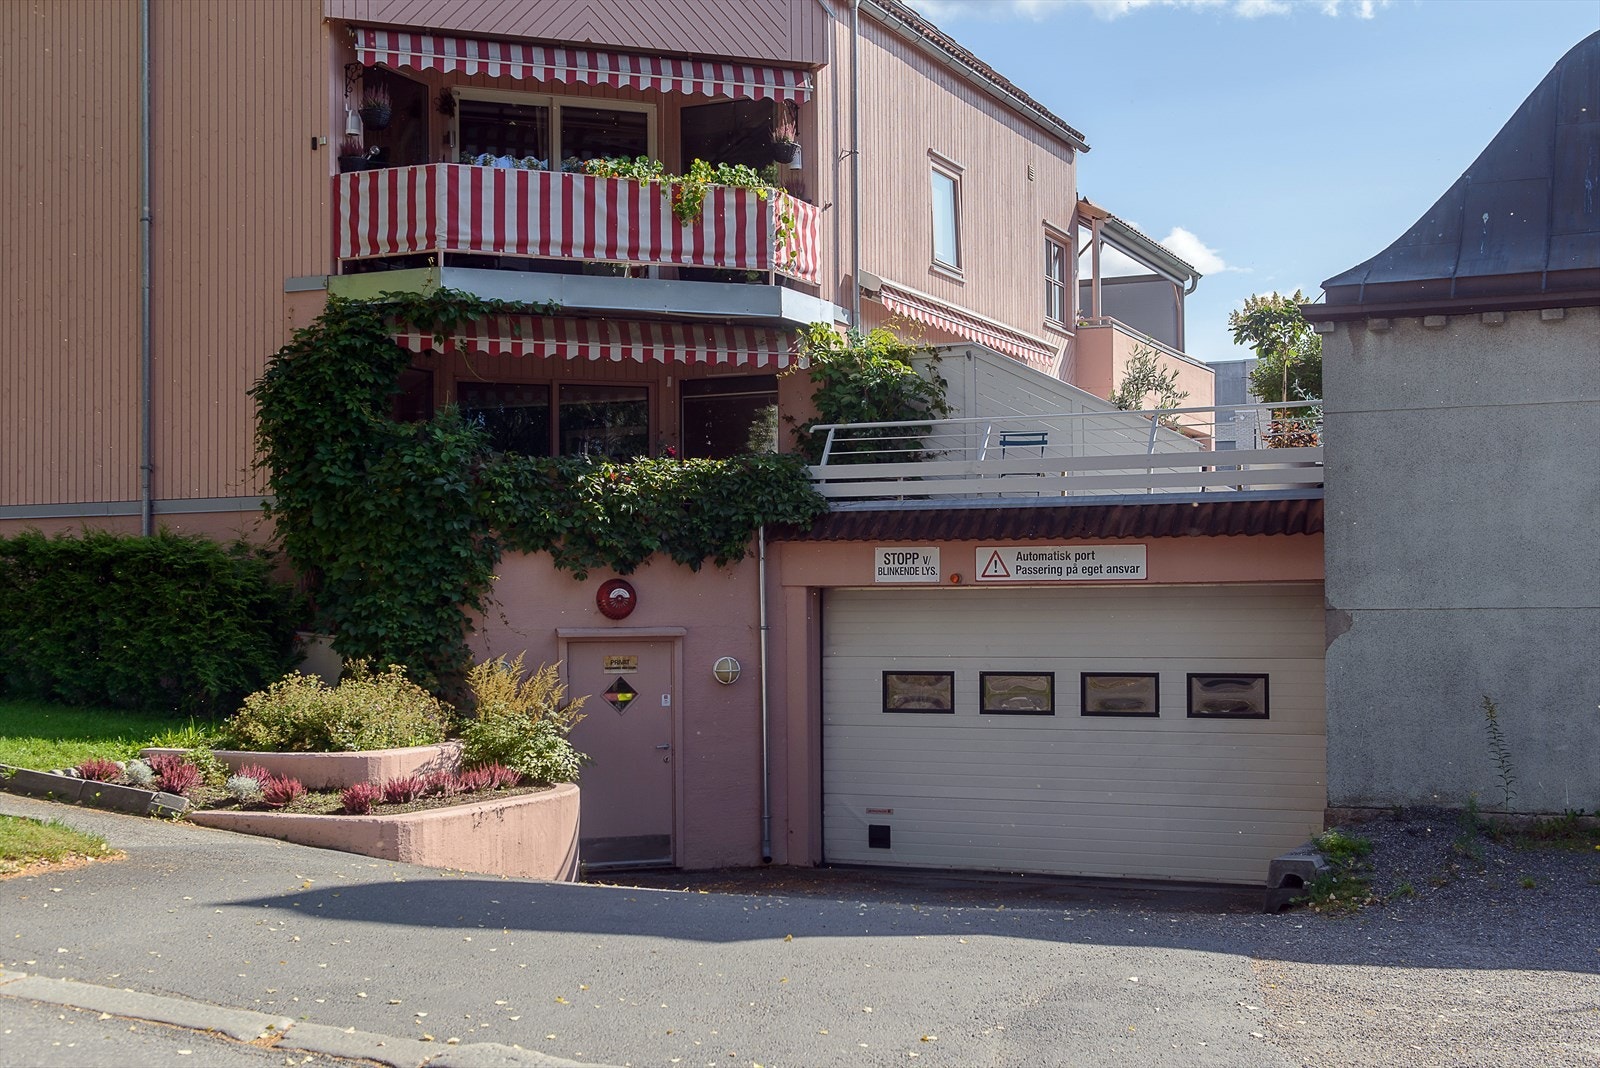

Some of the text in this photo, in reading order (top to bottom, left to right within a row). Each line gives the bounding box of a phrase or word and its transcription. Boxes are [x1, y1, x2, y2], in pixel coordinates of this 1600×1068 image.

[883, 552, 919, 565] STOPP
[1016, 550, 1096, 562] Automatisk port
[878, 566, 938, 576] BLINKENDE LYS.
[1015, 562, 1141, 576] Passering på eget ansvar
